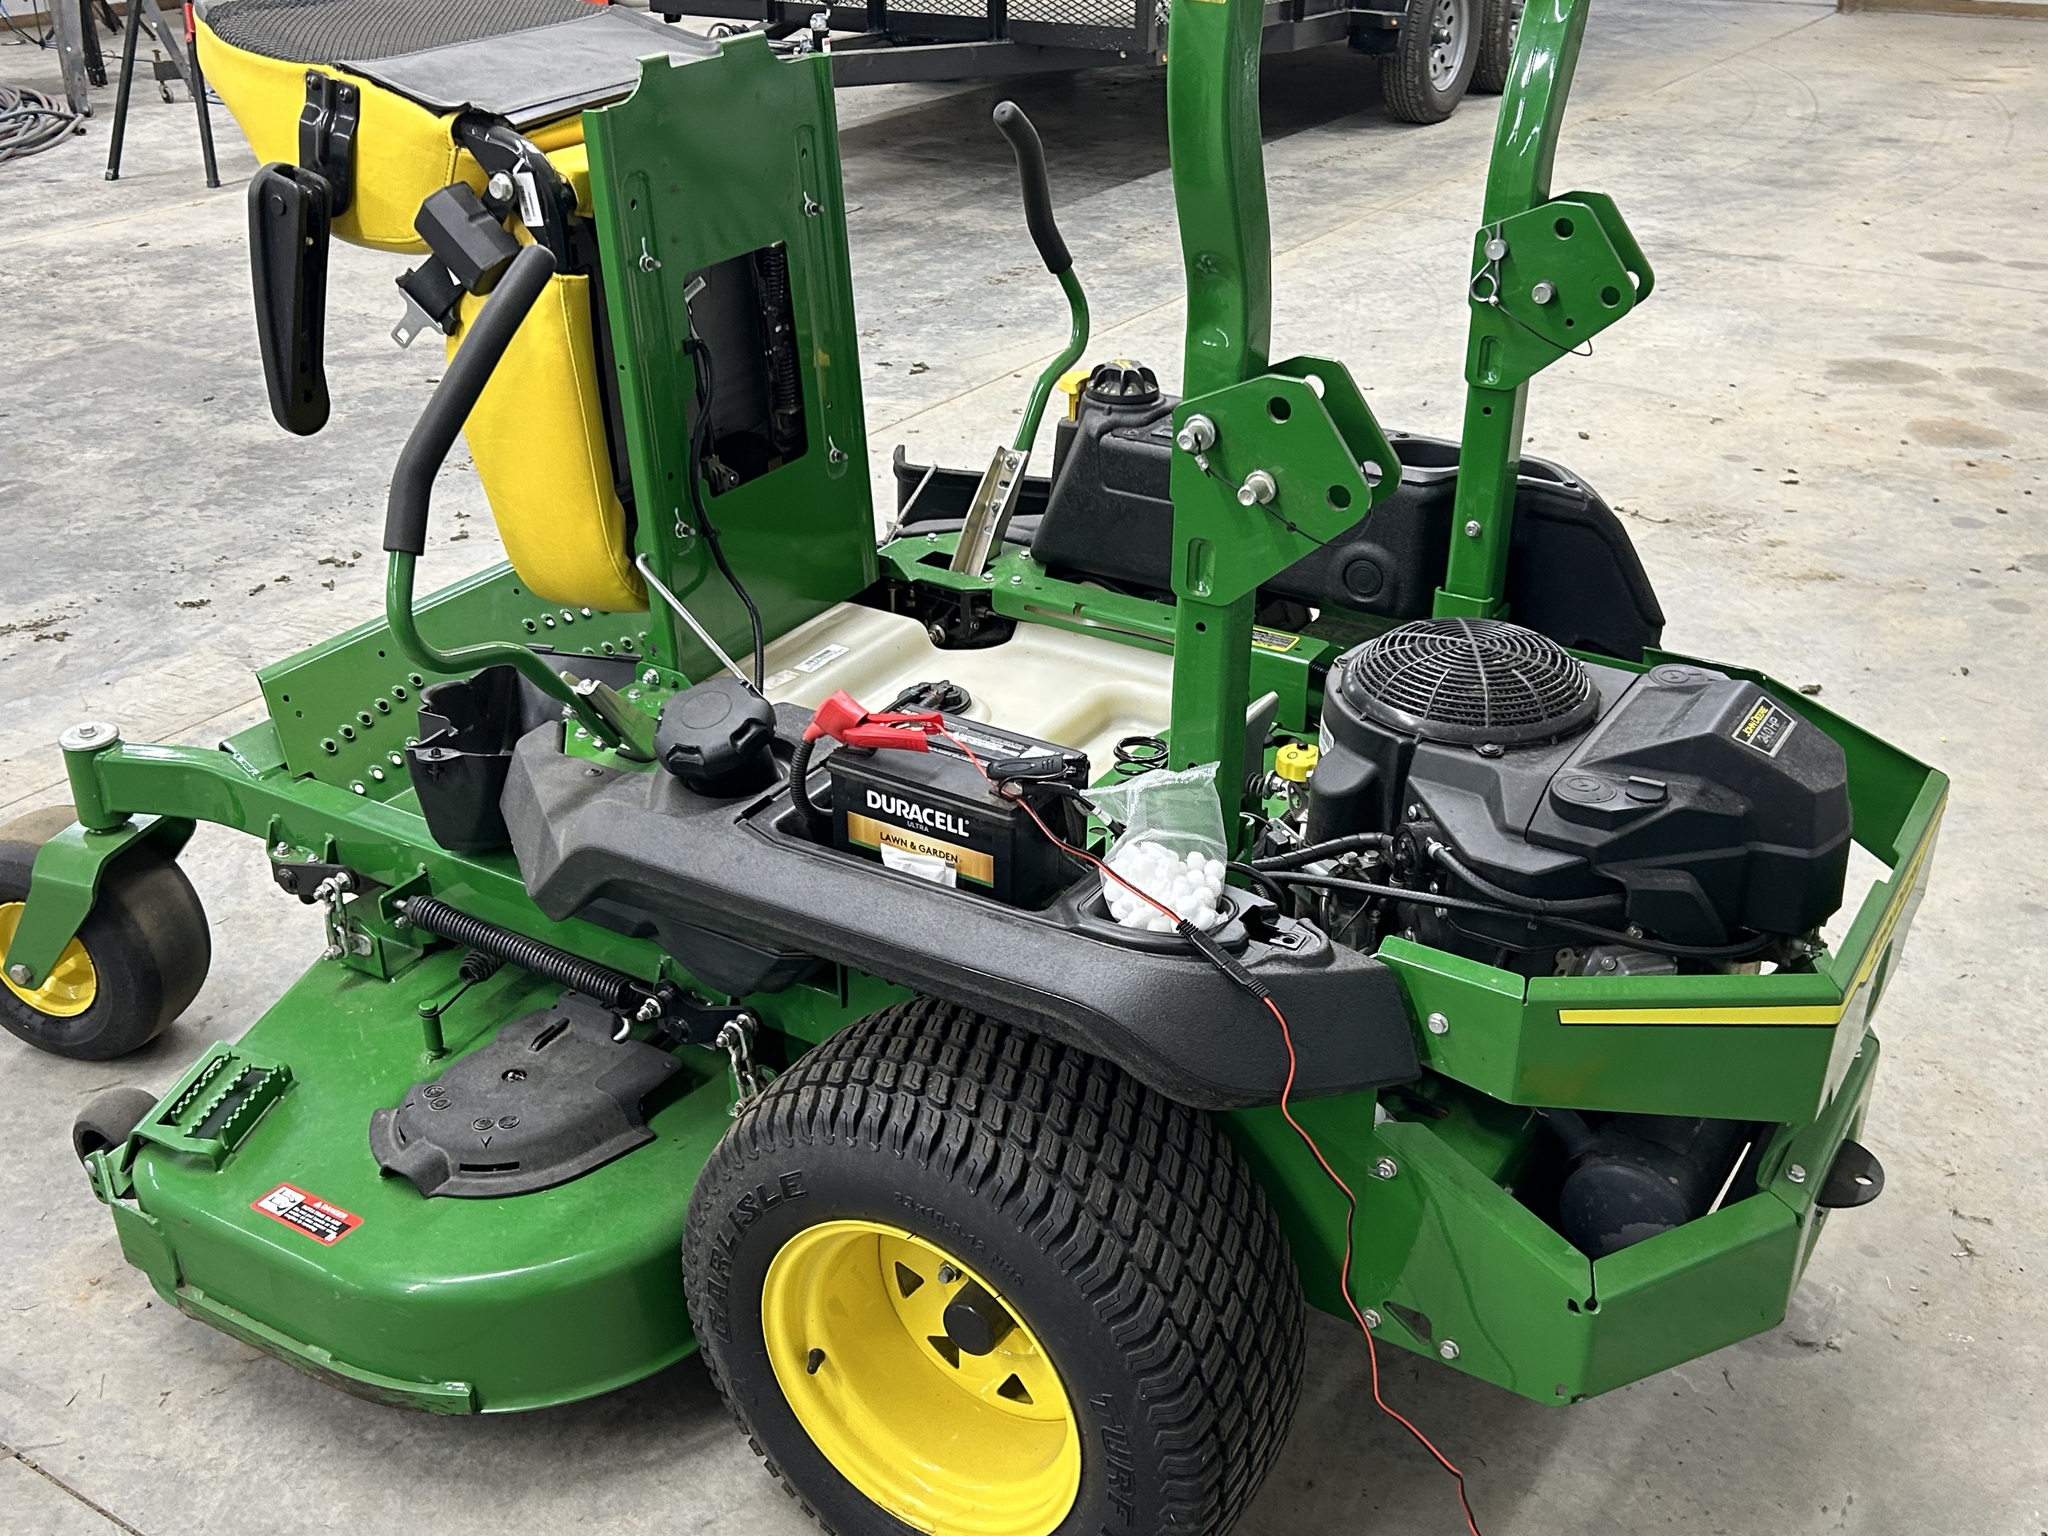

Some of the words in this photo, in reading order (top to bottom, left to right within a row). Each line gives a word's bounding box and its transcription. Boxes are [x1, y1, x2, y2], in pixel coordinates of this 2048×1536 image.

[1742, 720, 1758, 738] JOHN
[1750, 705, 1769, 725] DEERE
[1766, 716, 1781, 731] HP
[866, 789, 970, 838] DURACELL
[906, 820, 930, 833] ULTRA
[879, 831, 909, 848] LAWN
[909, 841, 917, 851] &
[918, 844, 959, 864] GARDEN
[321, 1203, 349, 1220] DANGER
[707, 1169, 809, 1343] CARLISLE
[1089, 1392, 1135, 1528] TURF
